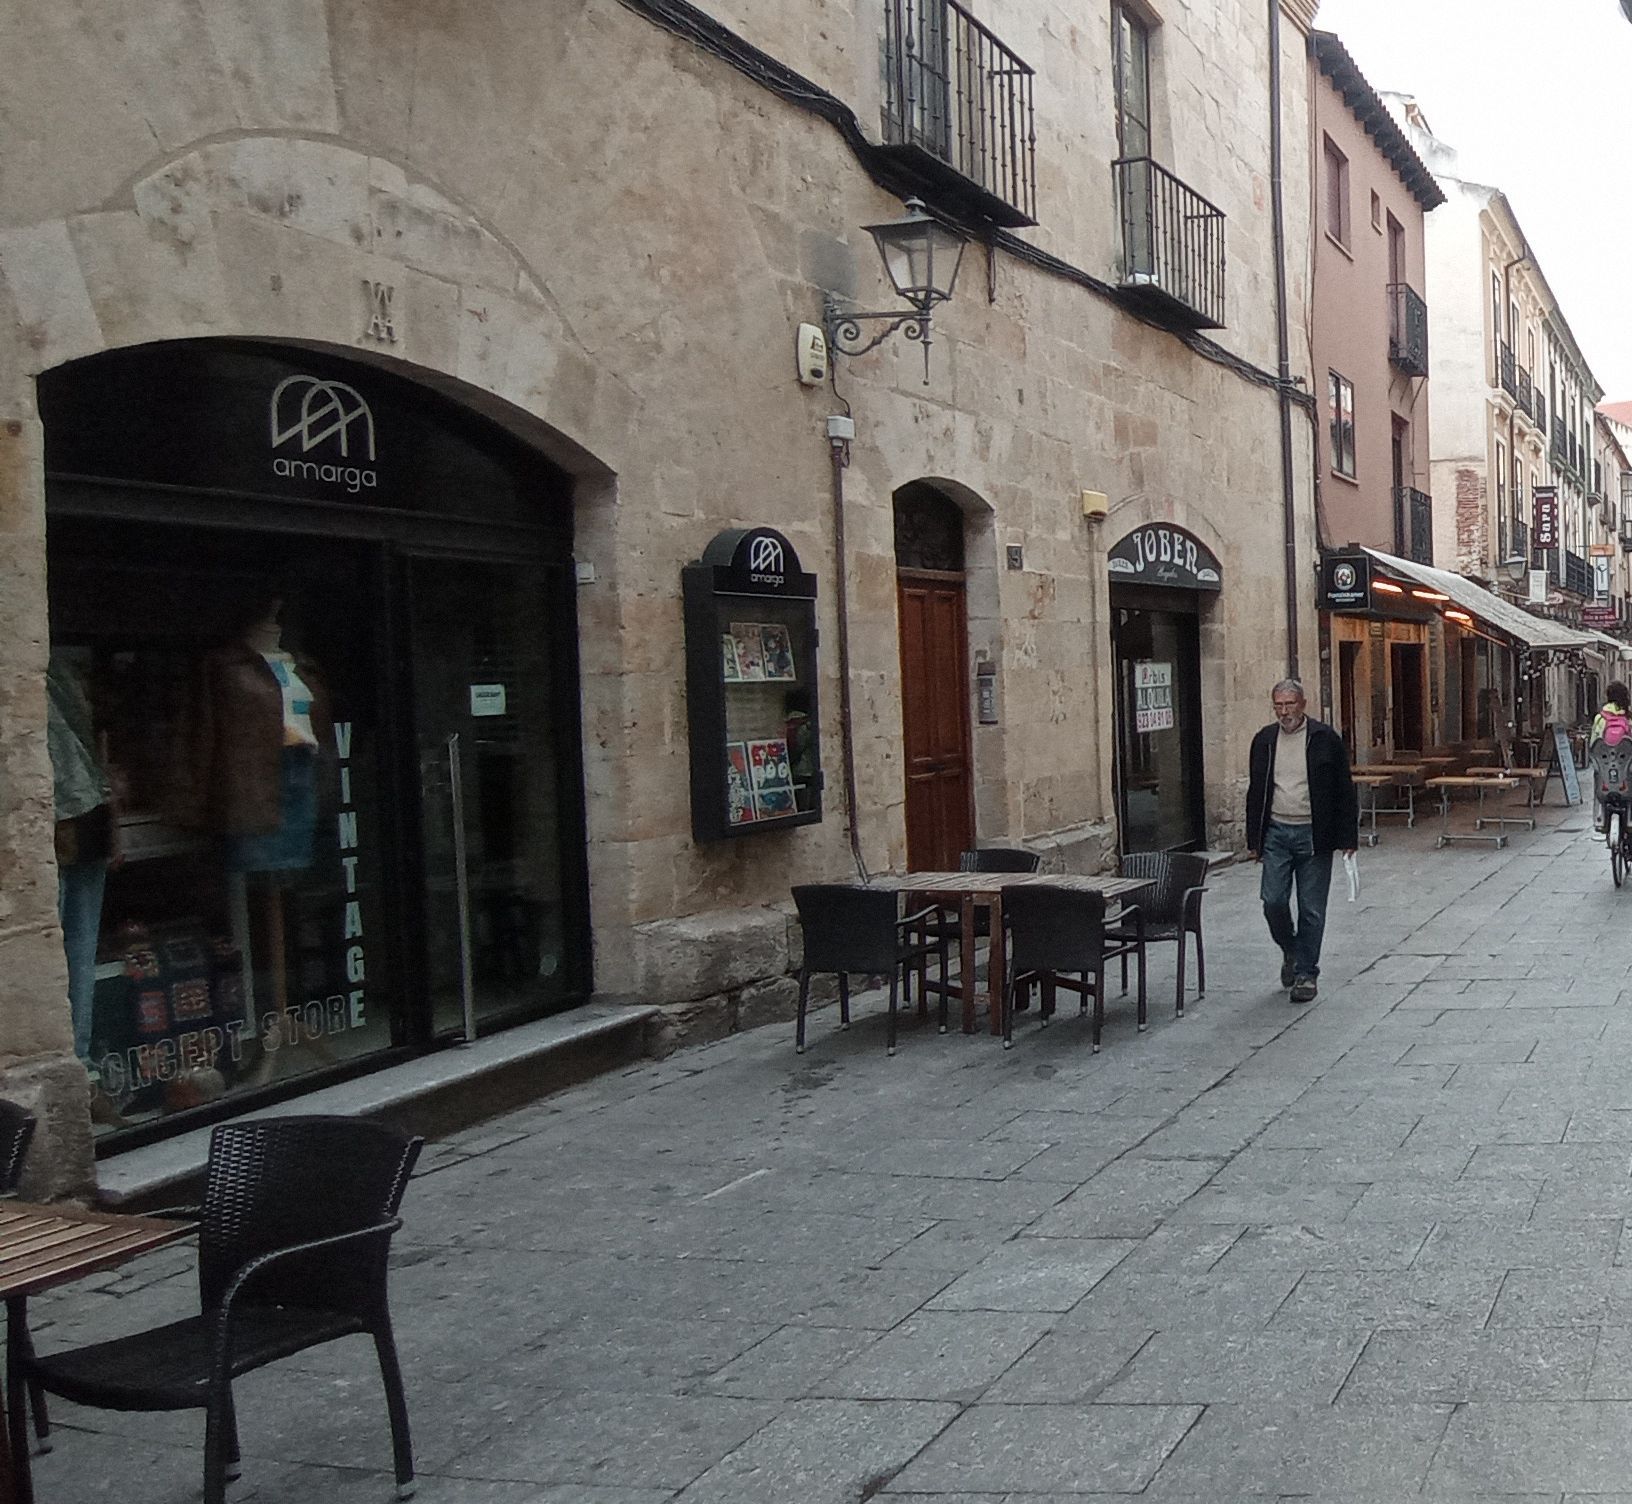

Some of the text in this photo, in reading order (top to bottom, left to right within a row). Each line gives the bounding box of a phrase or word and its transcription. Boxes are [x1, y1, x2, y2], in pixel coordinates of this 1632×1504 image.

[273, 458, 377, 493] amarga
[751, 573, 785, 588] amarga
[333, 722, 367, 1029] VINTAGE
